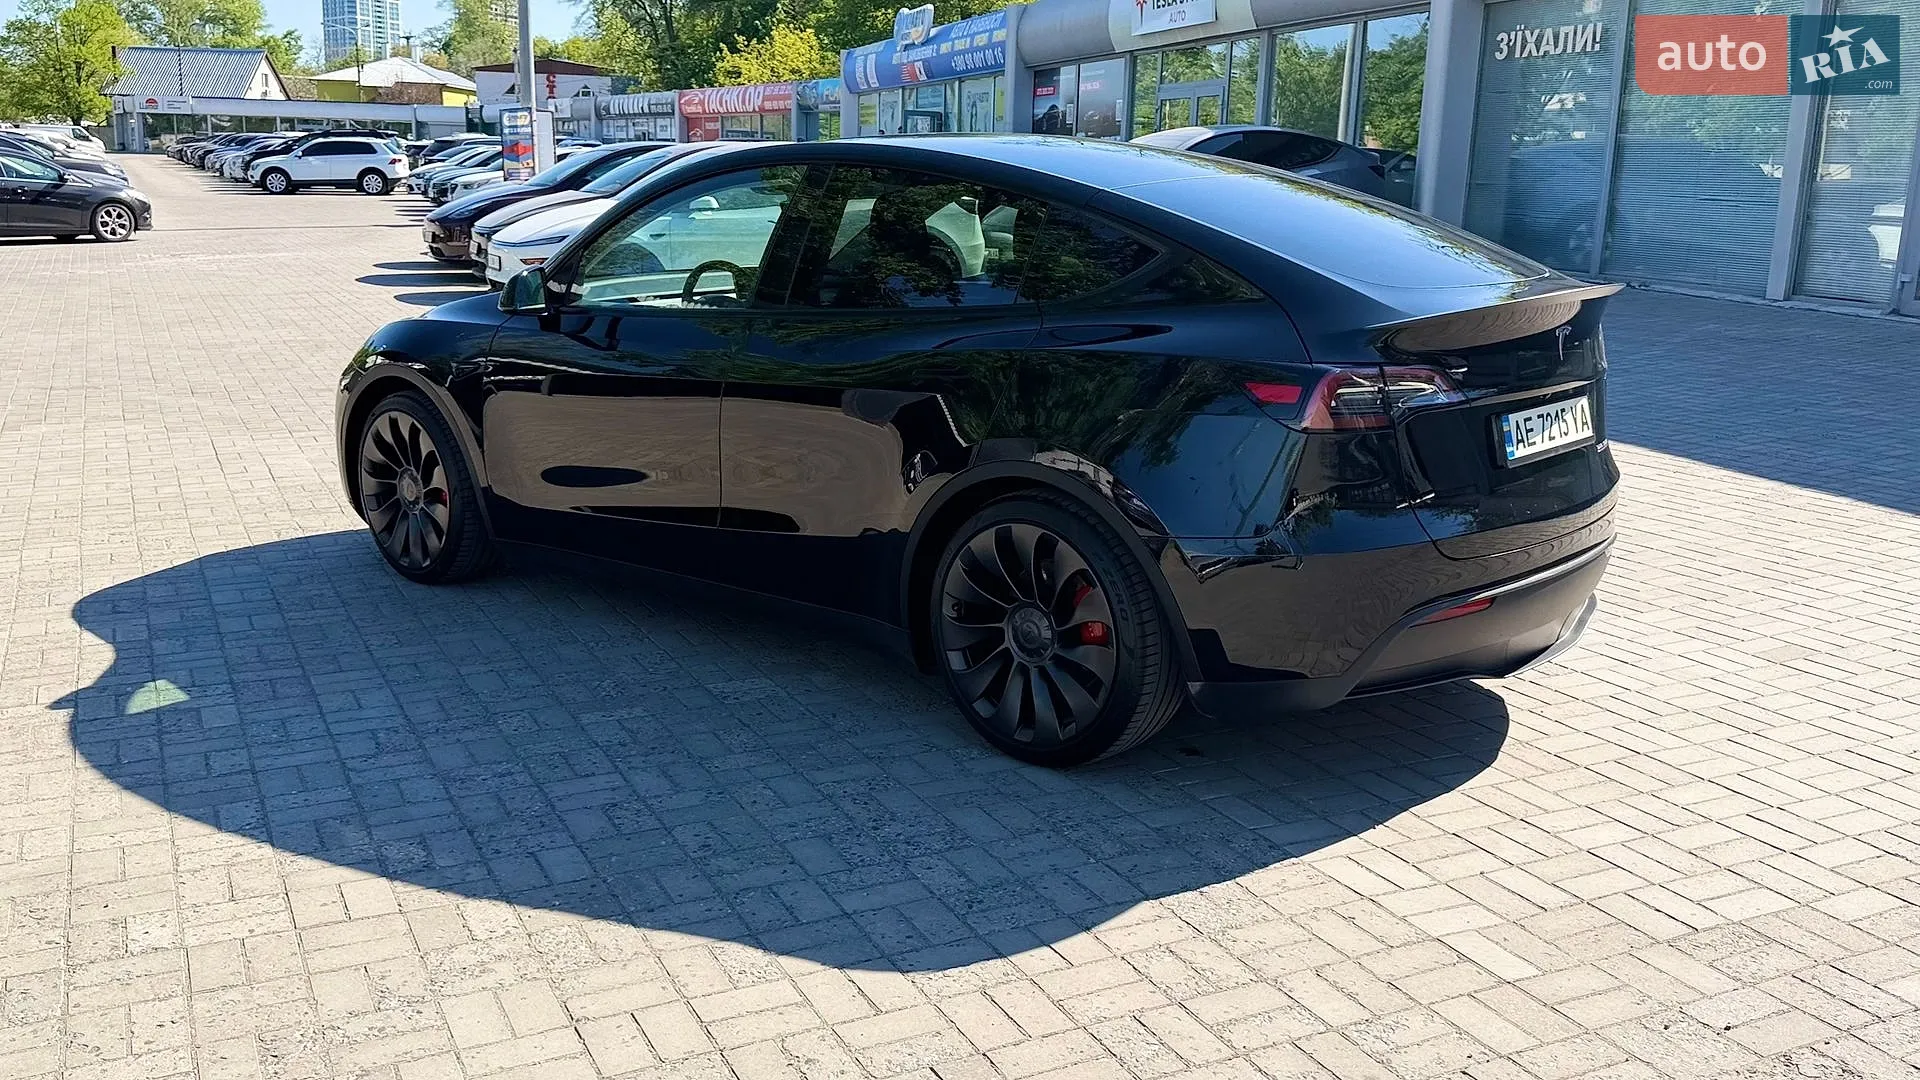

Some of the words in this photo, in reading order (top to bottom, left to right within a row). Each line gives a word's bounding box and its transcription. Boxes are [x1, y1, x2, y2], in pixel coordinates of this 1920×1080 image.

[1169, 10, 1186, 23] AUTO
[1494, 22, 1602, 60] З'ЇХАЛИ!
[1516, 417, 1537, 451] AE
[1537, 408, 1570, 444] 7215
[1571, 404, 1590, 433] YA
